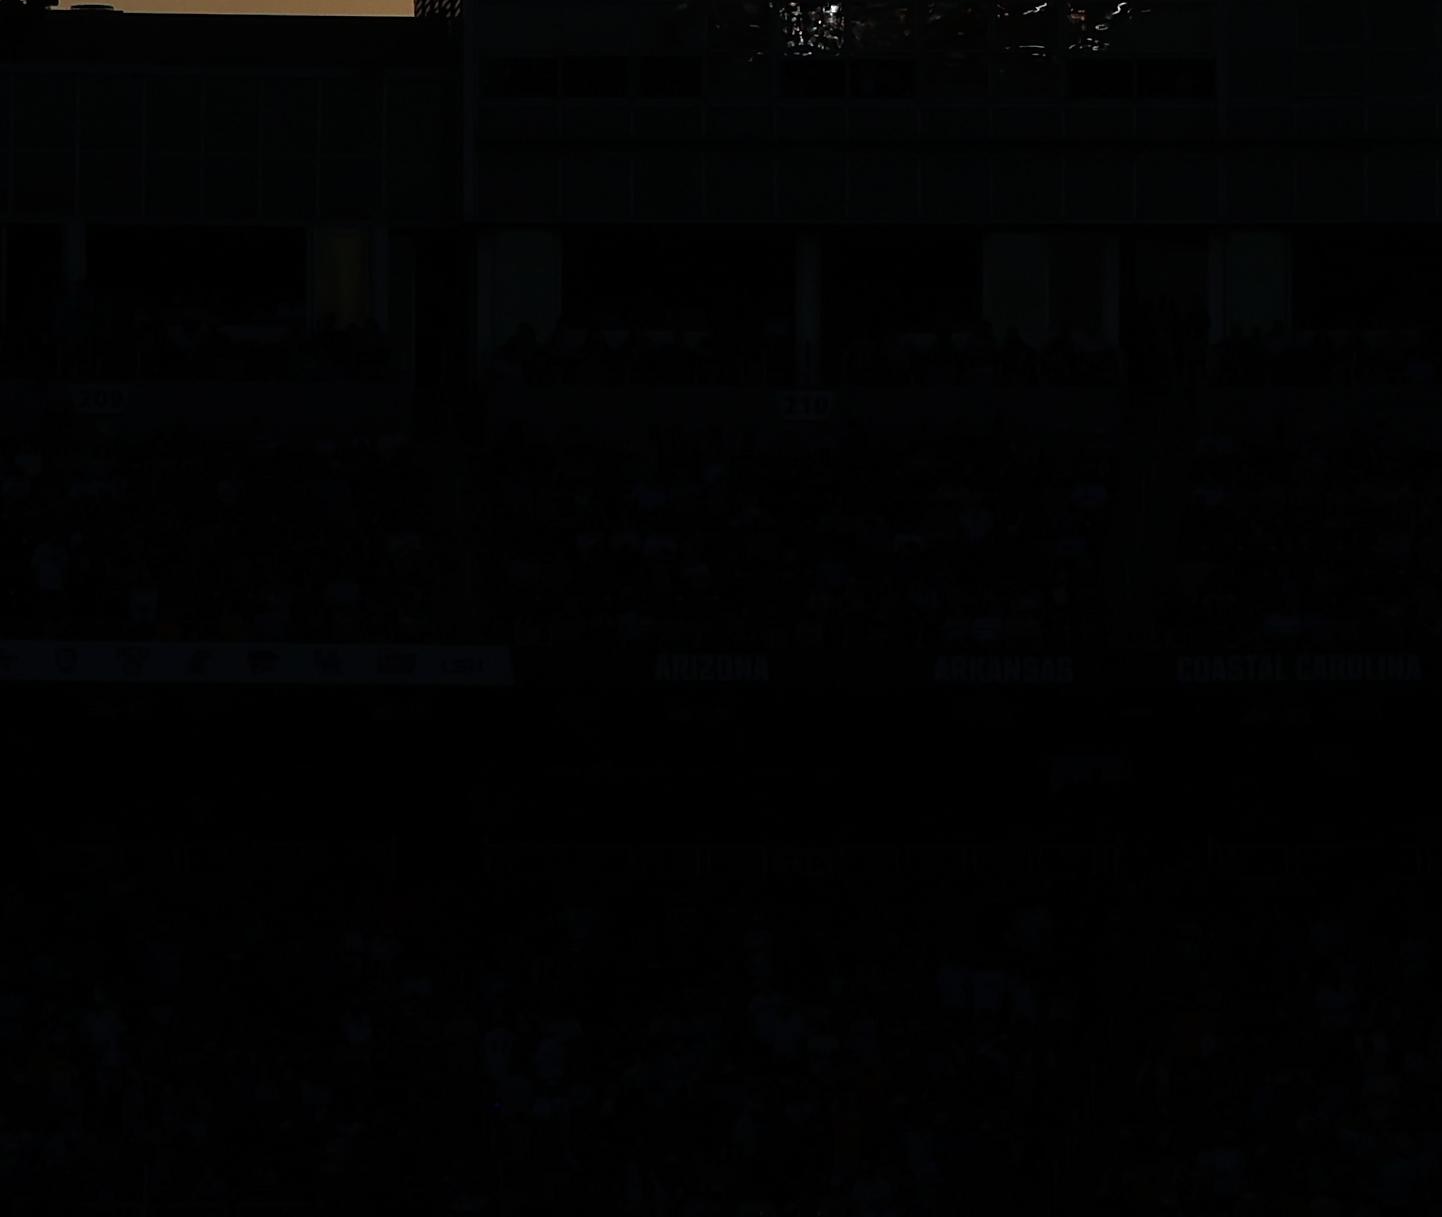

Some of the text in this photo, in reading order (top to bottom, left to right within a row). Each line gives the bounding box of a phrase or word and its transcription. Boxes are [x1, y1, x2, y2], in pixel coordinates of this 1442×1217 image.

[655, 654, 769, 681] ARIZONA
[933, 655, 1073, 682] ARKANSAS
[1175, 653, 1422, 682] COASTAL CAROLINA
